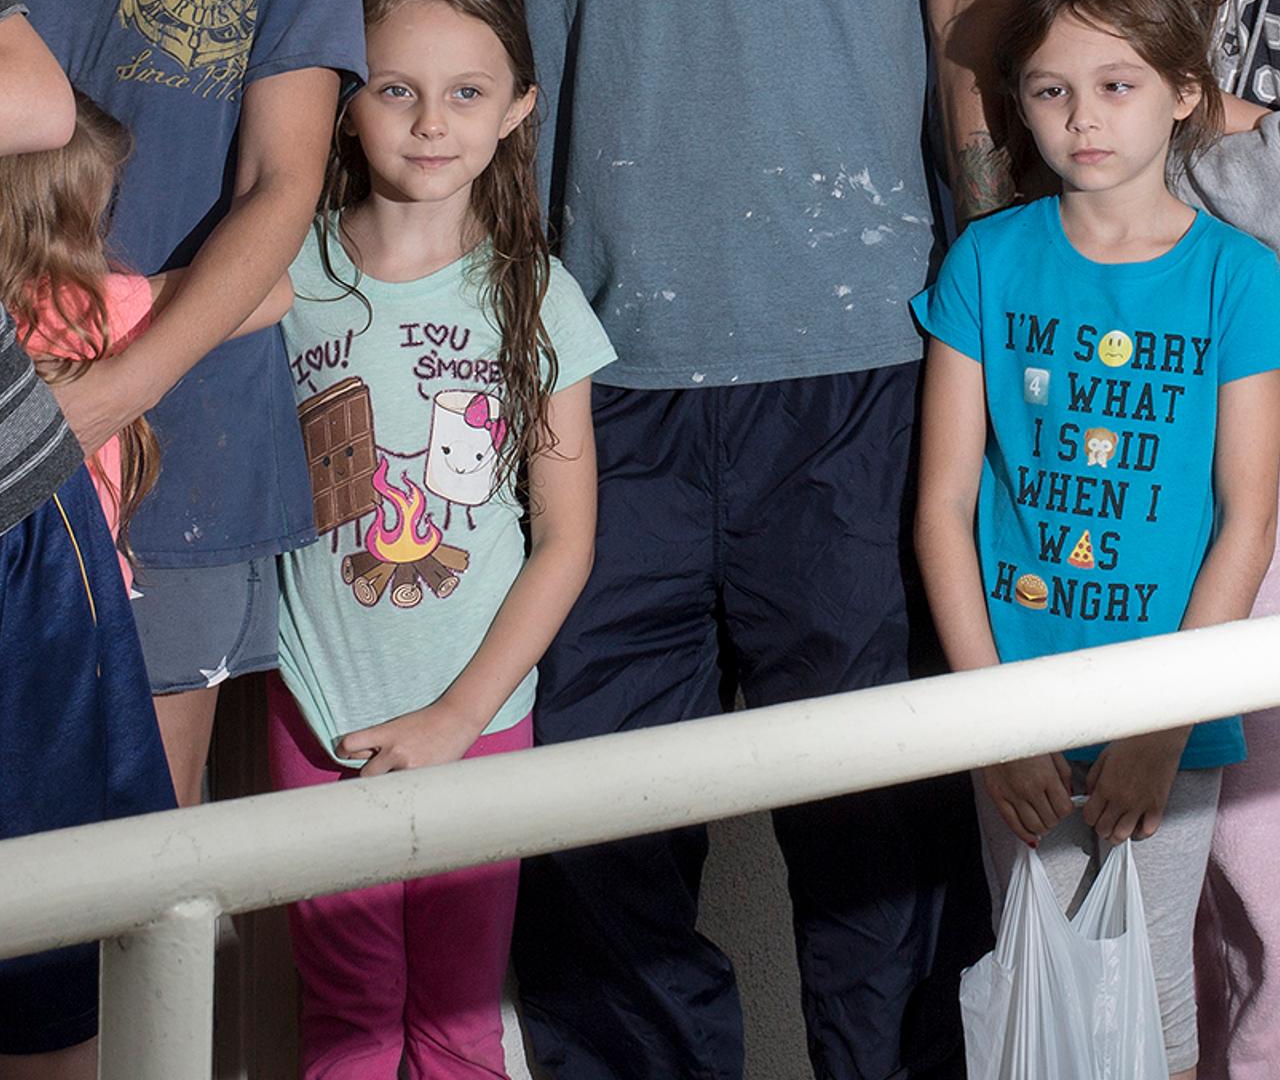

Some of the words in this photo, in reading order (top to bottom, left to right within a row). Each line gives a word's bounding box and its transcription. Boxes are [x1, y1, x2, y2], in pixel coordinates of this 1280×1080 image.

[115, 49, 190, 88] Since
[1005, 311, 1060, 357] I'M
[1073, 324, 1212, 376] SRRY
[1067, 371, 1186, 424] WHAT
[1032, 418, 1043, 458] I
[1057, 422, 1161, 472] SID
[1016, 466, 1130, 520] WHEN
[1145, 484, 1162, 523] I
[1038, 521, 1122, 570] WS
[990, 561, 1159, 622] HNGRY
